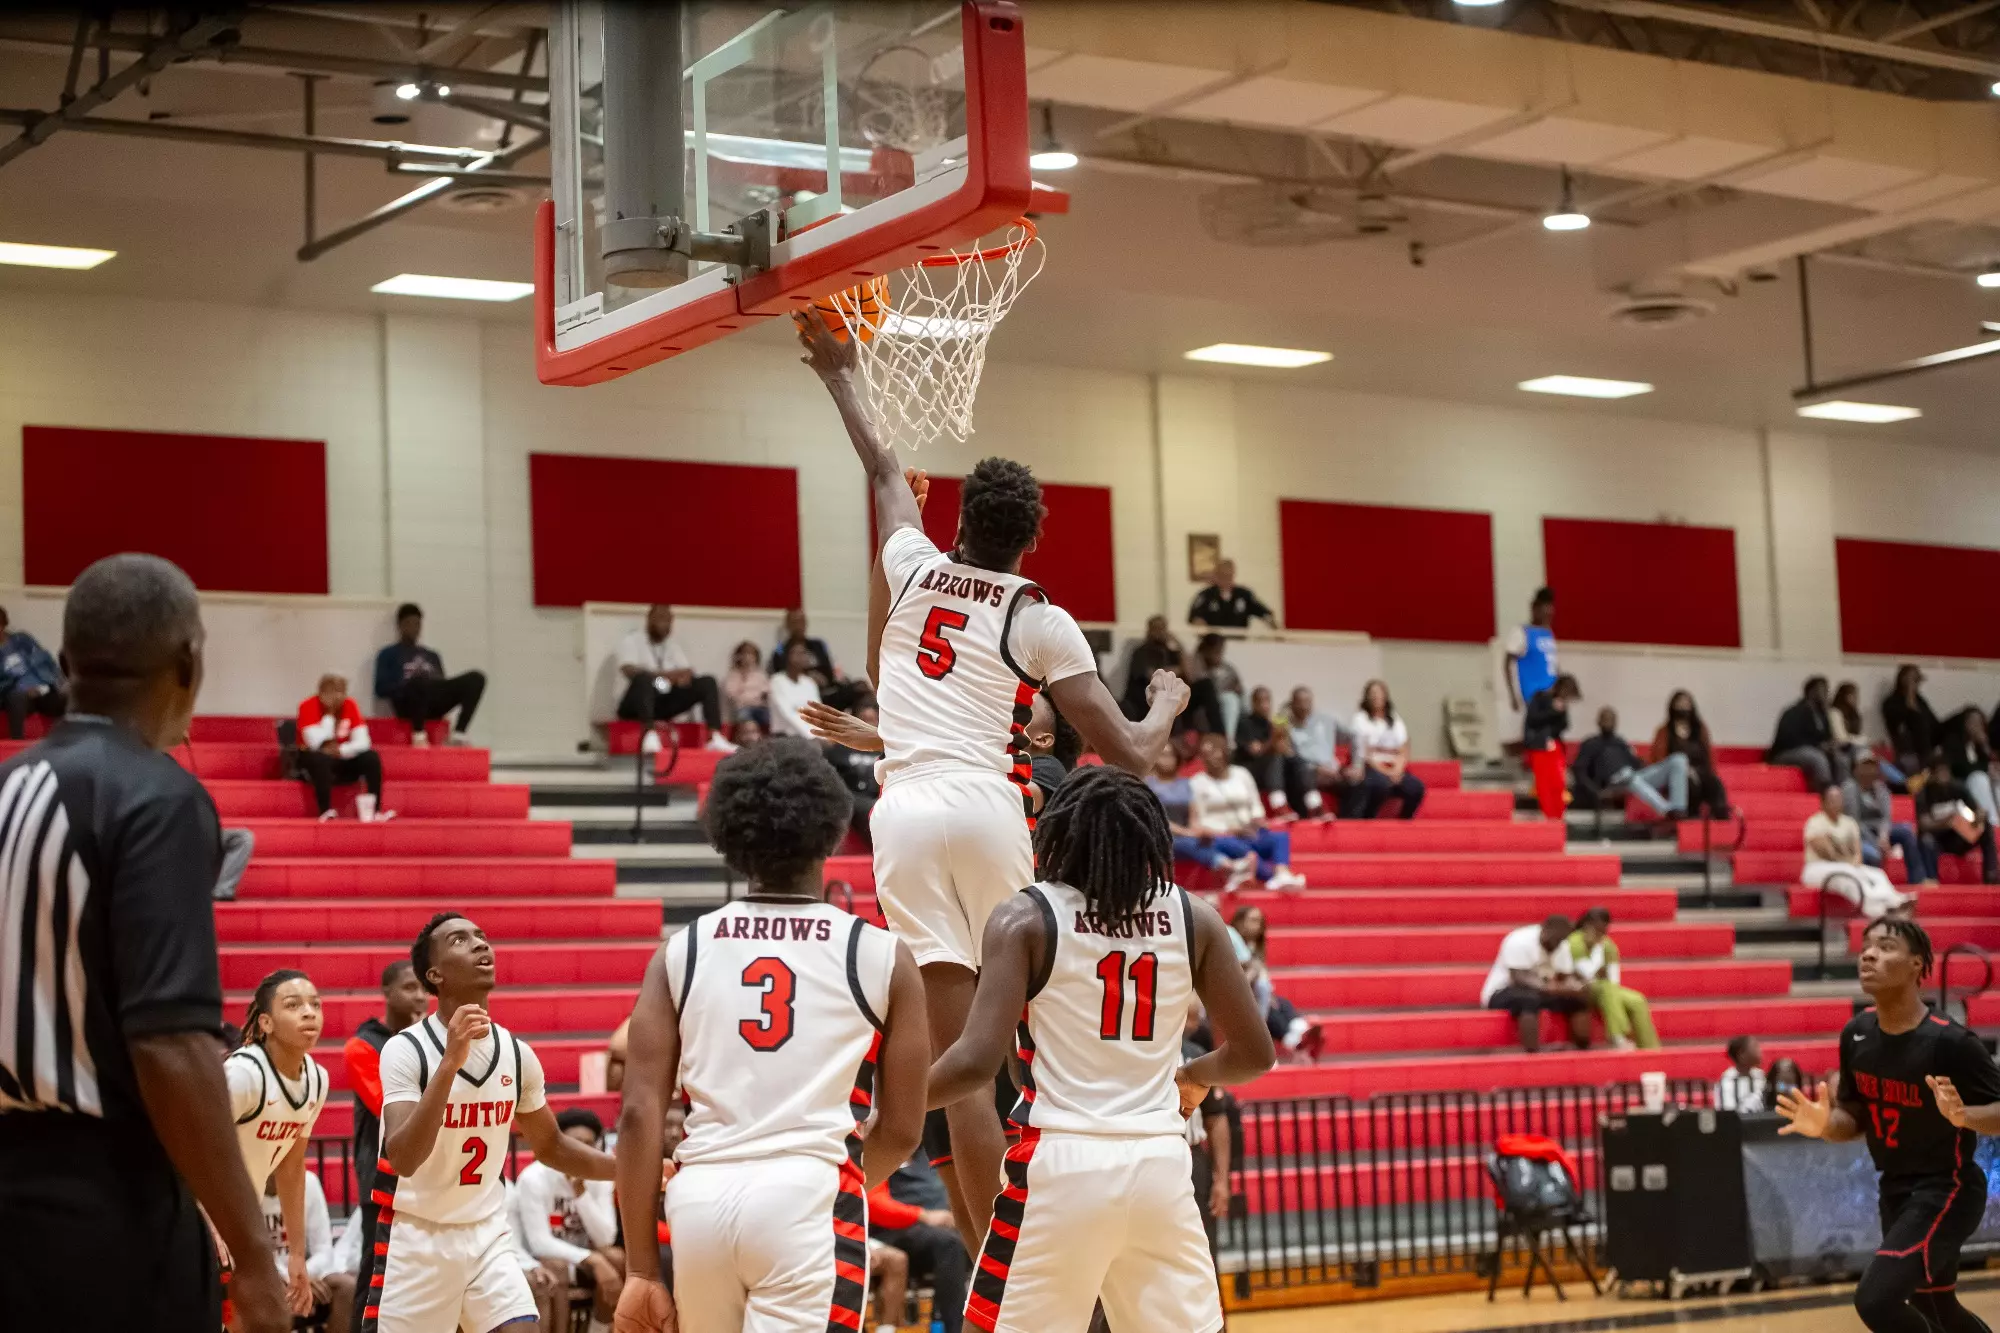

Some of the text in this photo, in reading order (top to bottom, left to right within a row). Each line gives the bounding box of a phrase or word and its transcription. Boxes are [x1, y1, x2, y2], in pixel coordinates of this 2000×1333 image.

[918, 569, 1005, 608] ARROWS
[915, 605, 970, 681] 5
[713, 916, 832, 941] ARROWS
[738, 956, 796, 1052] 3
[1096, 950, 1158, 1041] 11
[441, 1100, 514, 1129] LINTON
[1868, 1103, 1900, 1148] 12
[459, 1136, 488, 1186] 2
